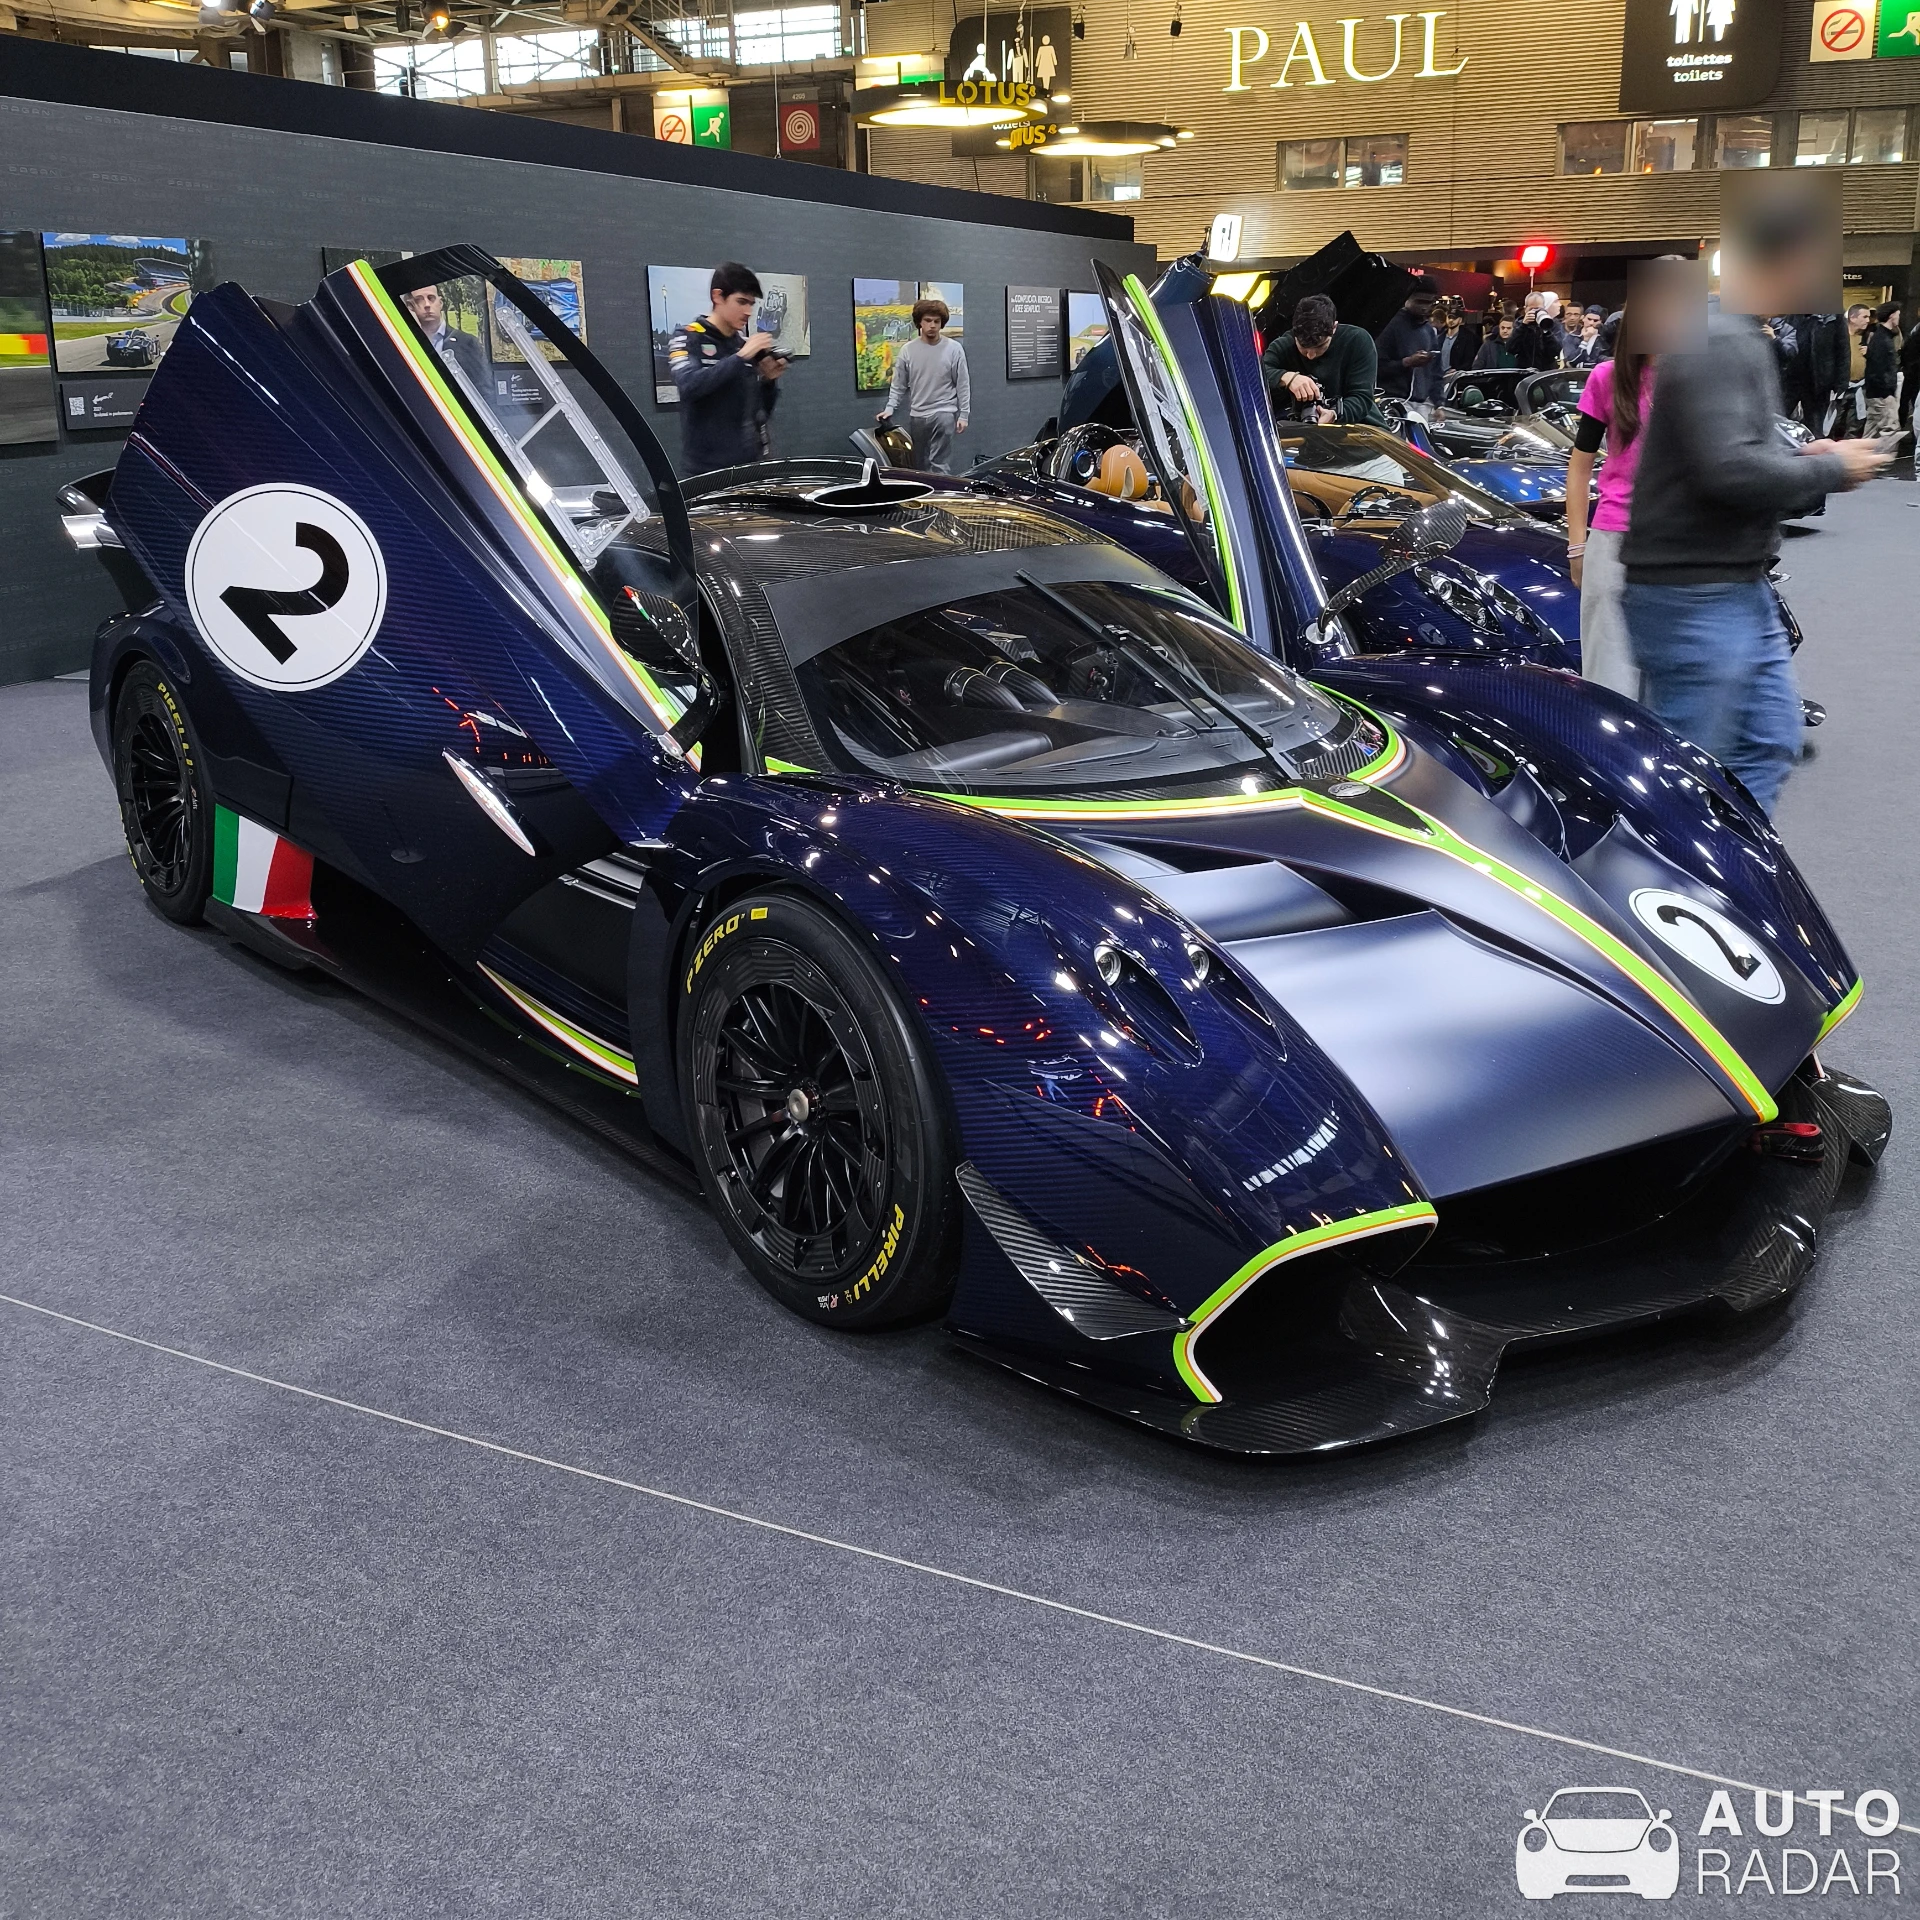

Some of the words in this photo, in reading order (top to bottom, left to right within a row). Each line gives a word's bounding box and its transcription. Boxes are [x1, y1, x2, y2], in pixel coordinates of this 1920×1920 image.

[1223, 11, 1469, 92] PAUL
[1666, 53, 1733, 67] toilettes
[1673, 69, 1723, 83] toilets
[939, 81, 1030, 106] LOTUS
[219, 522, 350, 665] 2
[686, 967, 694, 994] P
[694, 914, 740, 975] ZERO
[1656, 905, 1762, 981] 2
[853, 1203, 905, 1301] PIRELLI
